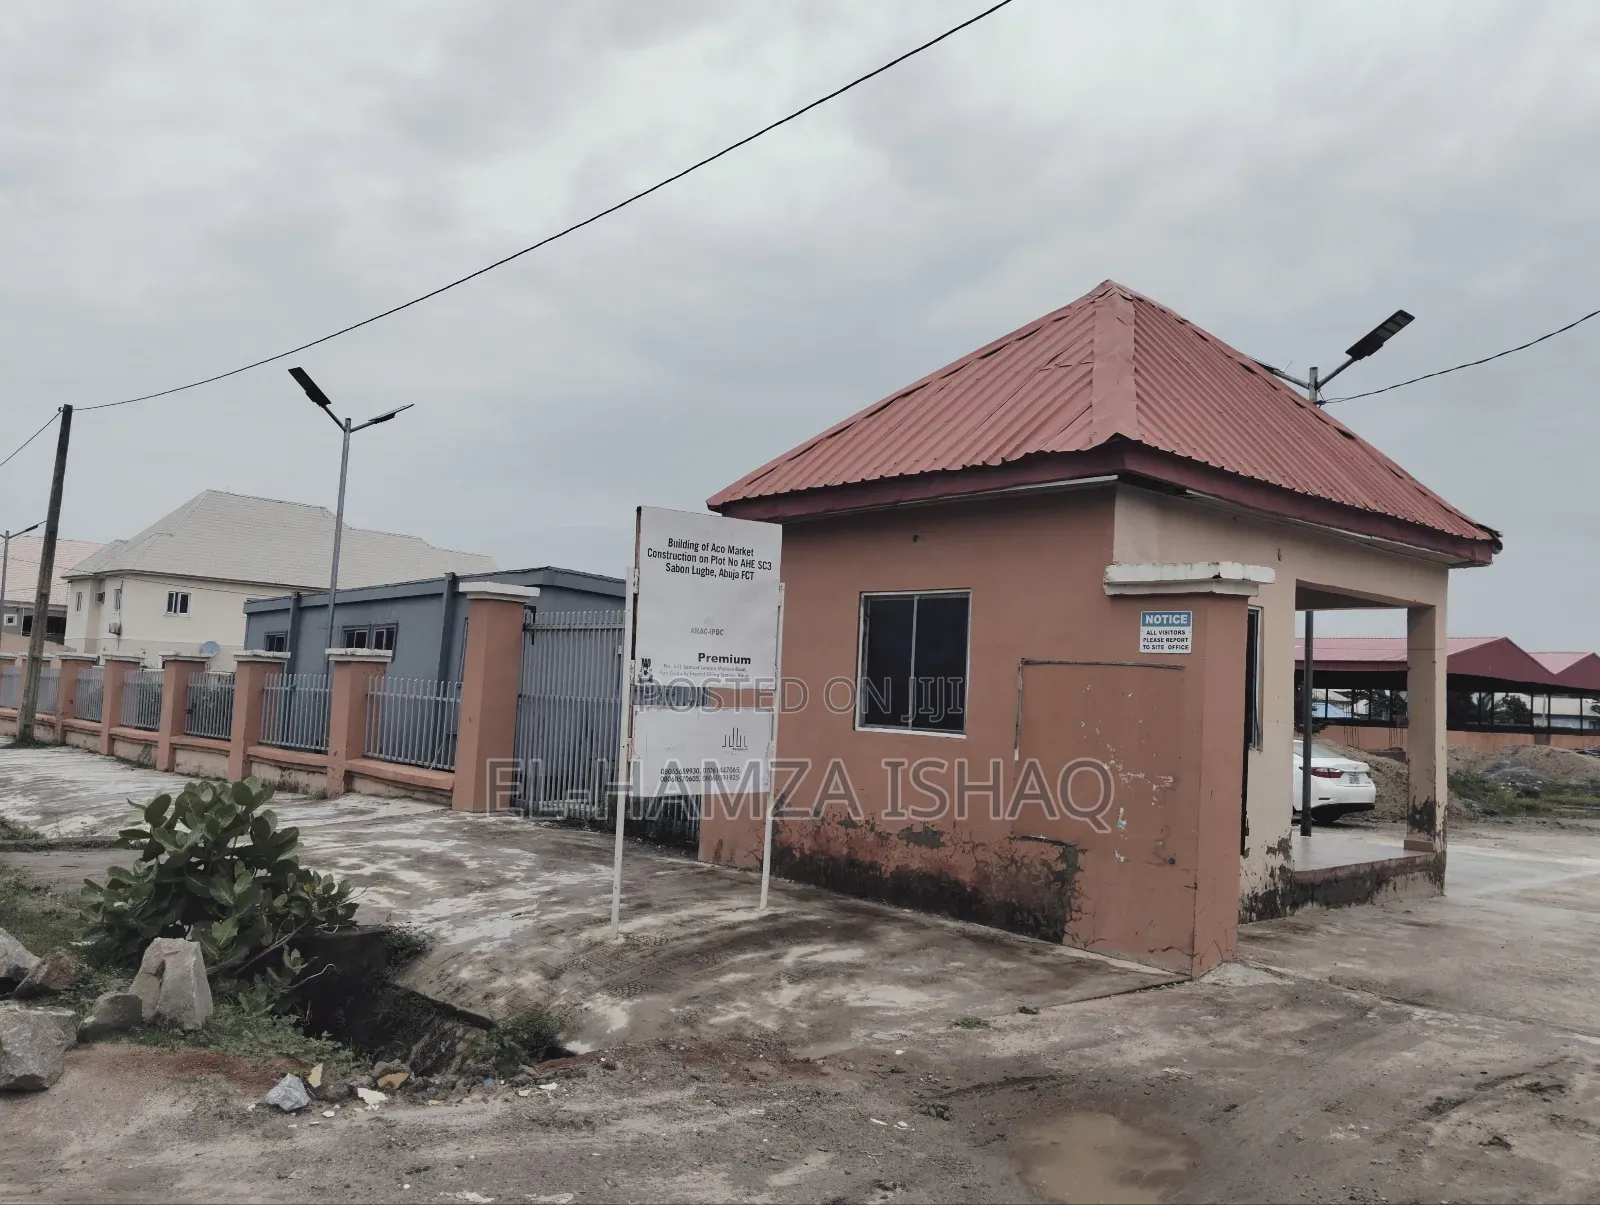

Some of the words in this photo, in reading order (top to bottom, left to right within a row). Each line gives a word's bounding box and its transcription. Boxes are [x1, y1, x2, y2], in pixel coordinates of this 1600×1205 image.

[668, 538, 699, 552] Building
[702, 542, 710, 551] of
[711, 544, 725, 554] Aco
[728, 545, 754, 557] Market
[648, 548, 696, 562] Construction
[699, 555, 709, 564] on
[711, 555, 725, 566] Plot
[728, 557, 738, 566] No
[741, 559, 755, 568] AHE
[758, 561, 772, 570] SC3
[666, 563, 689, 574] Sabon
[692, 565, 716, 578] Lugbe,
[719, 569, 739, 580] Abuja
[741, 571, 754, 580] FCT
[1146, 614, 1188, 624] NOTICE
[698, 653, 752, 665] Premium
